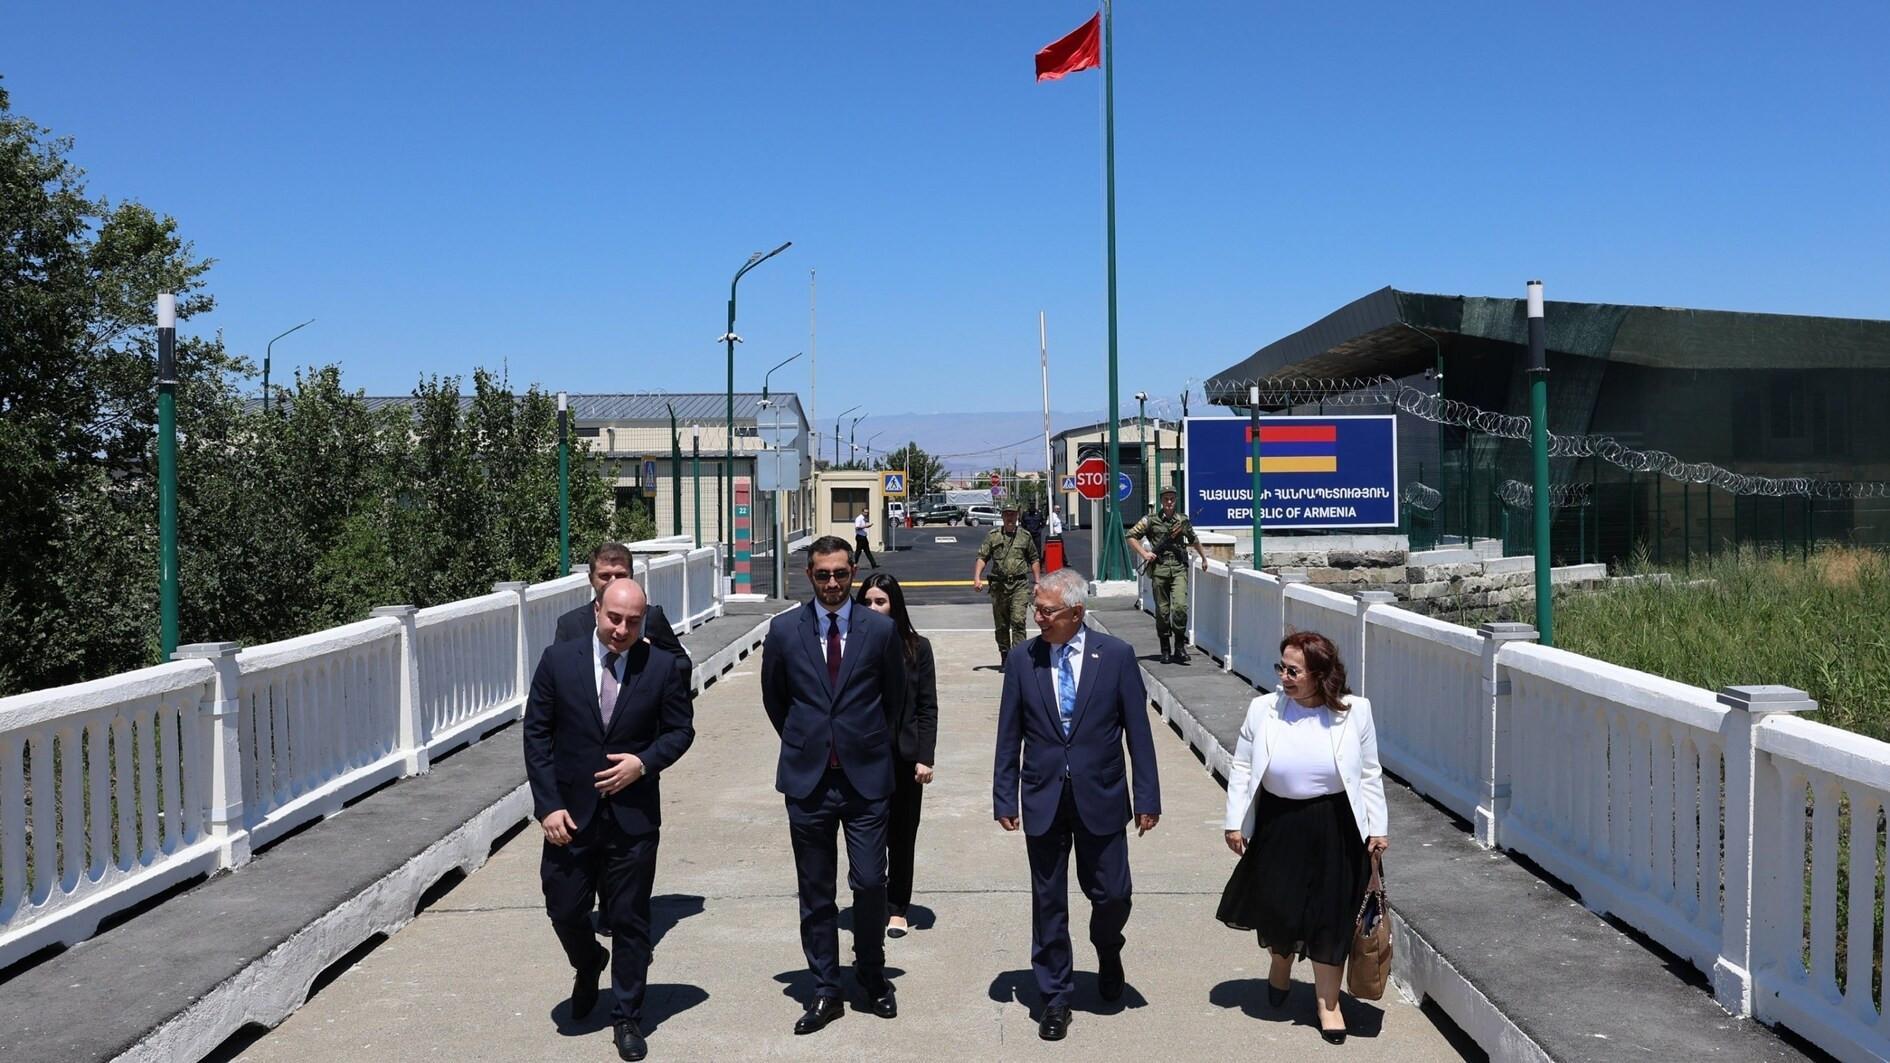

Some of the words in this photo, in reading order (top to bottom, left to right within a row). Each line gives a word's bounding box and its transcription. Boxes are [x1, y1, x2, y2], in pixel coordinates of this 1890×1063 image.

[1274, 487, 1390, 500] ՀԱՆՐԱՊԵՏՈՒԹՅՈՒՆ
[1286, 507, 1301, 519] OF
[1303, 506, 1357, 518] ARMENIA
